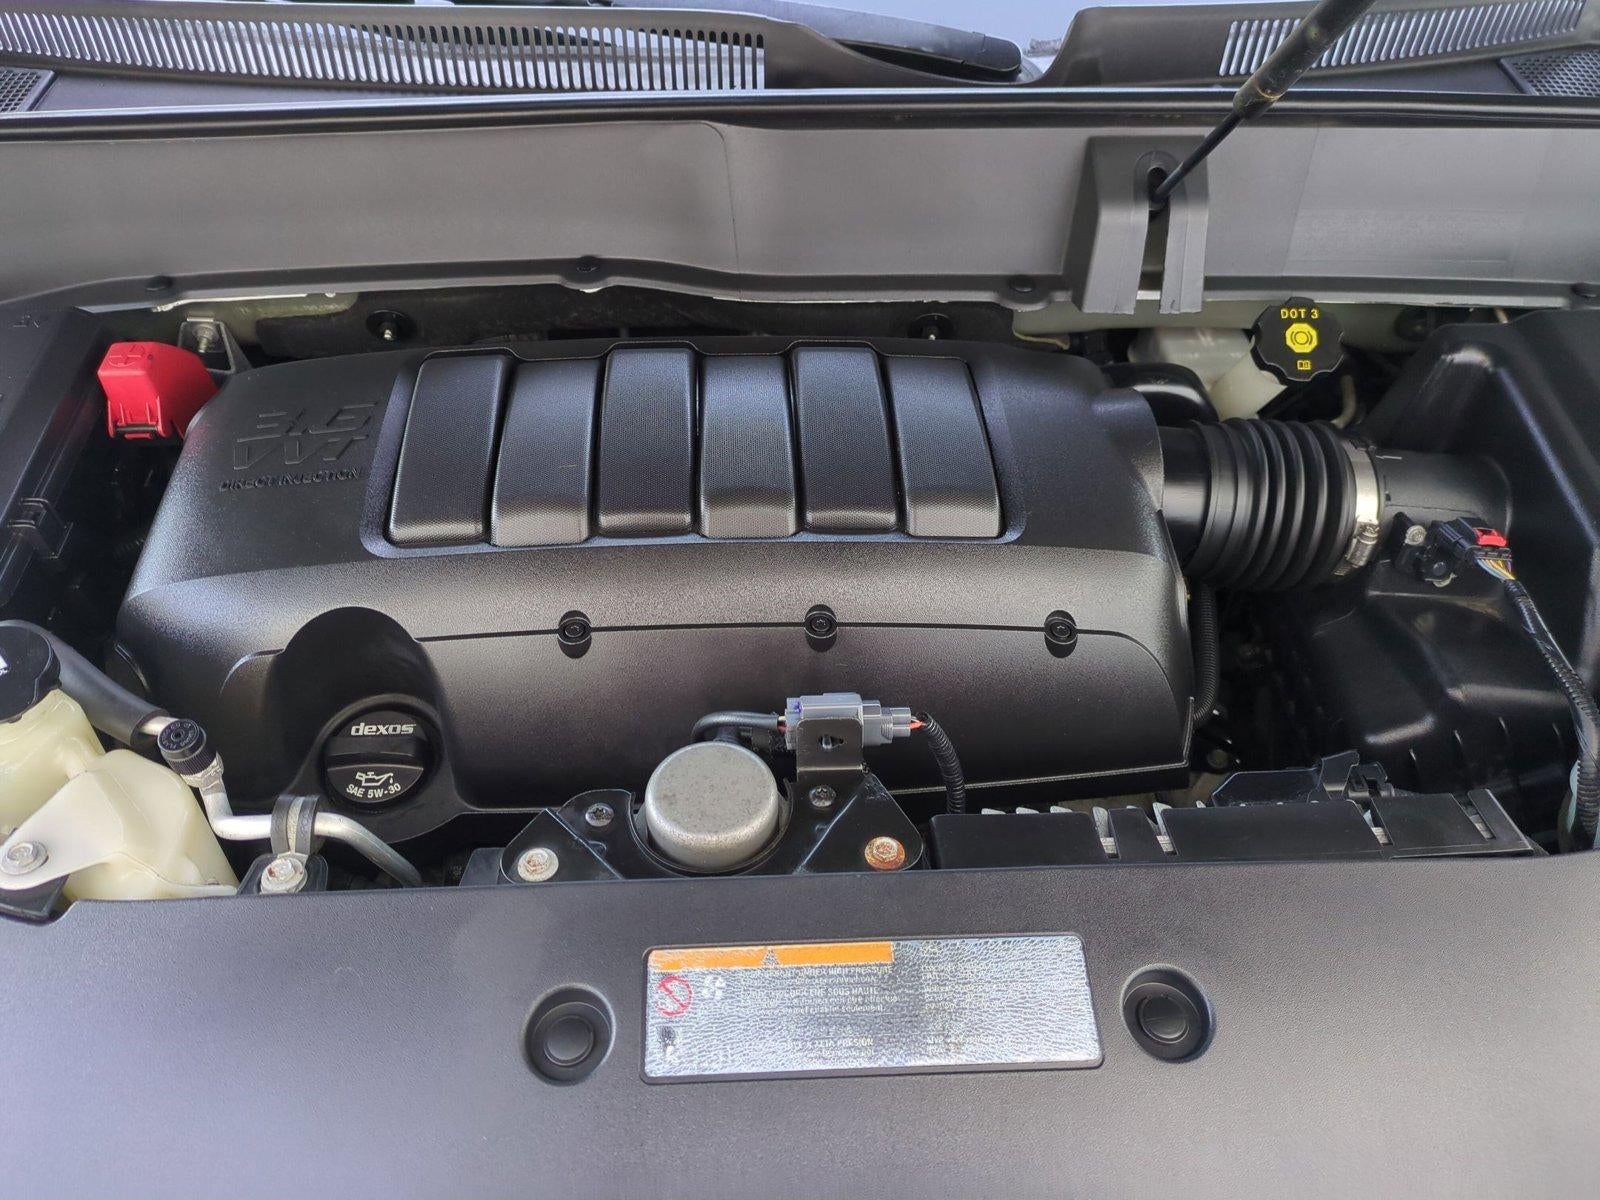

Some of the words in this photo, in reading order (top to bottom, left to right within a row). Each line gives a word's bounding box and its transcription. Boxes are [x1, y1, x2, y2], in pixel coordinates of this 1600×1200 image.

[1280, 308, 1306, 319] DOT
[1310, 308, 1319, 319] 3
[233, 433, 369, 470] VVT
[219, 475, 275, 491] DIRECT
[278, 467, 361, 486] INJECTION
[350, 722, 416, 736] dexos
[346, 783, 365, 798] SAE
[367, 783, 402, 799] 5W-30
